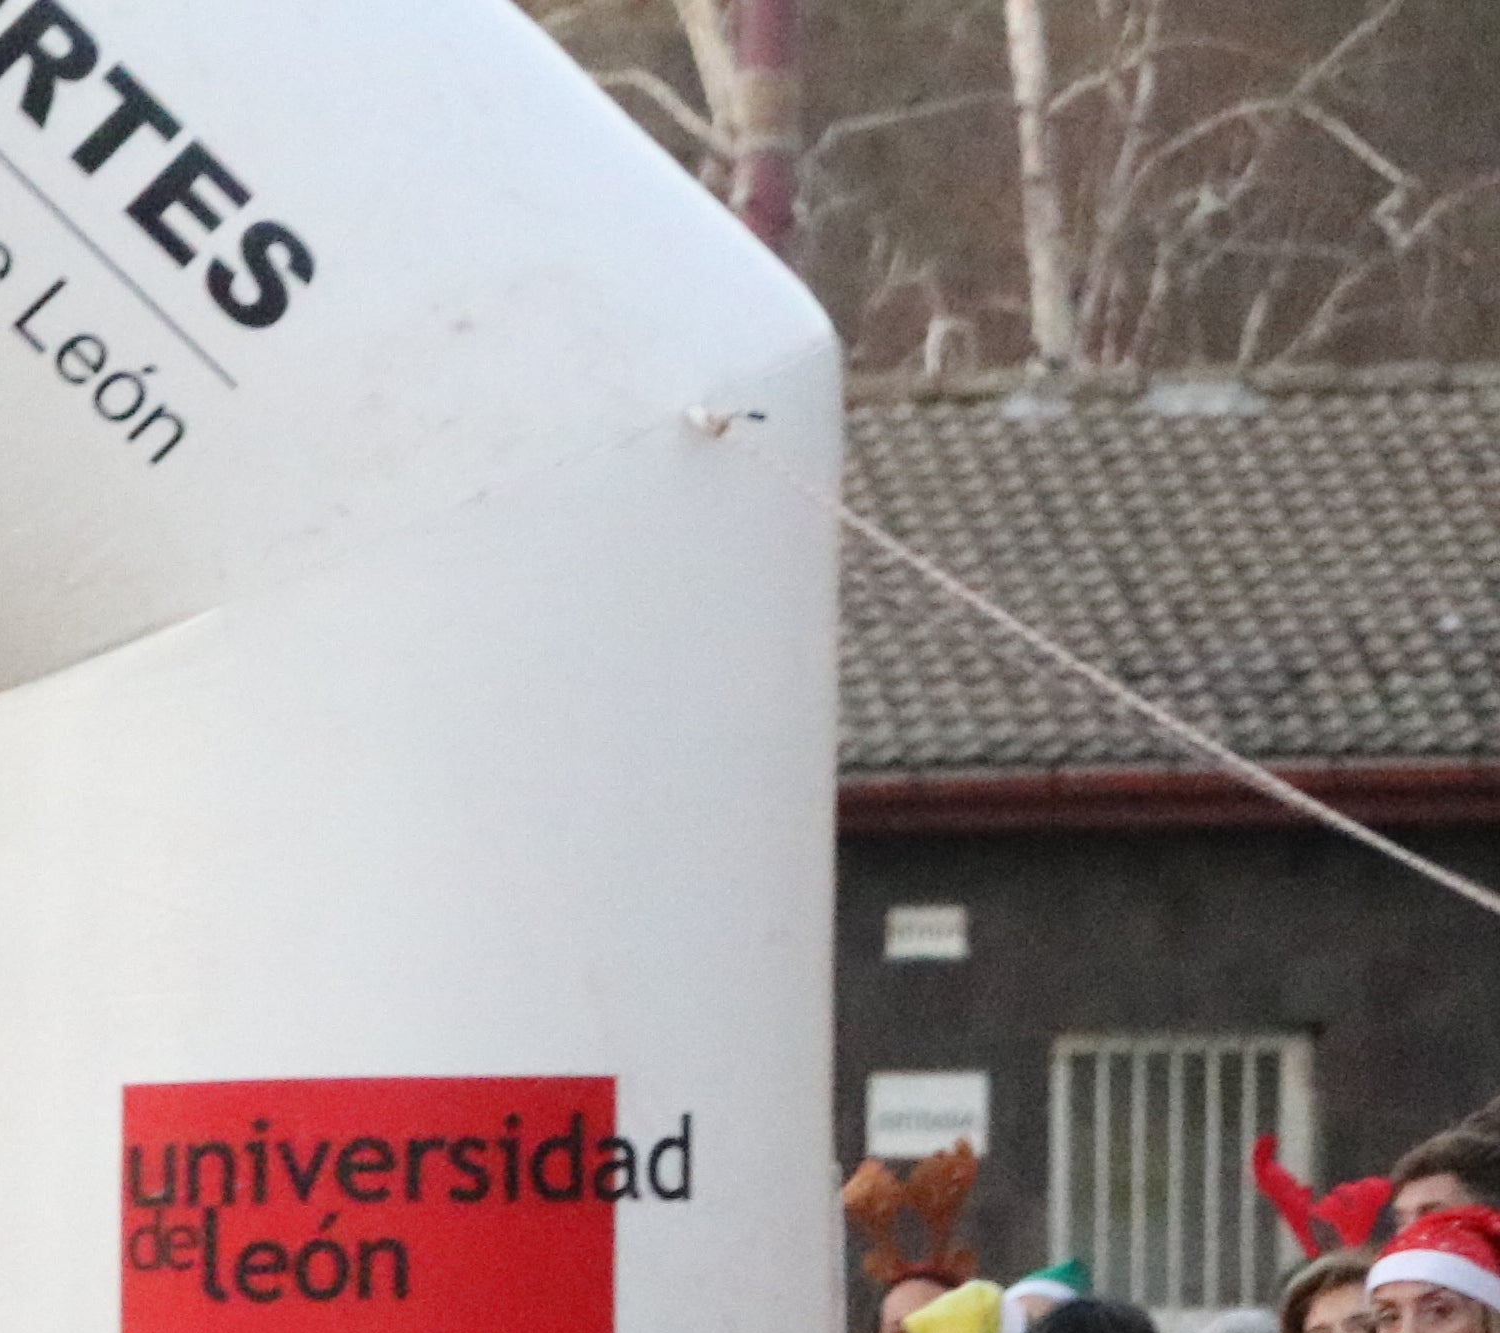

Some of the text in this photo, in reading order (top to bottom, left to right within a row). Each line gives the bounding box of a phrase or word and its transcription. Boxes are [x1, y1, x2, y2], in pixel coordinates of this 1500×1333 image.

[13, 277, 187, 466] León
[127, 1111, 694, 1208] universidad
[127, 1206, 411, 1302] de león
